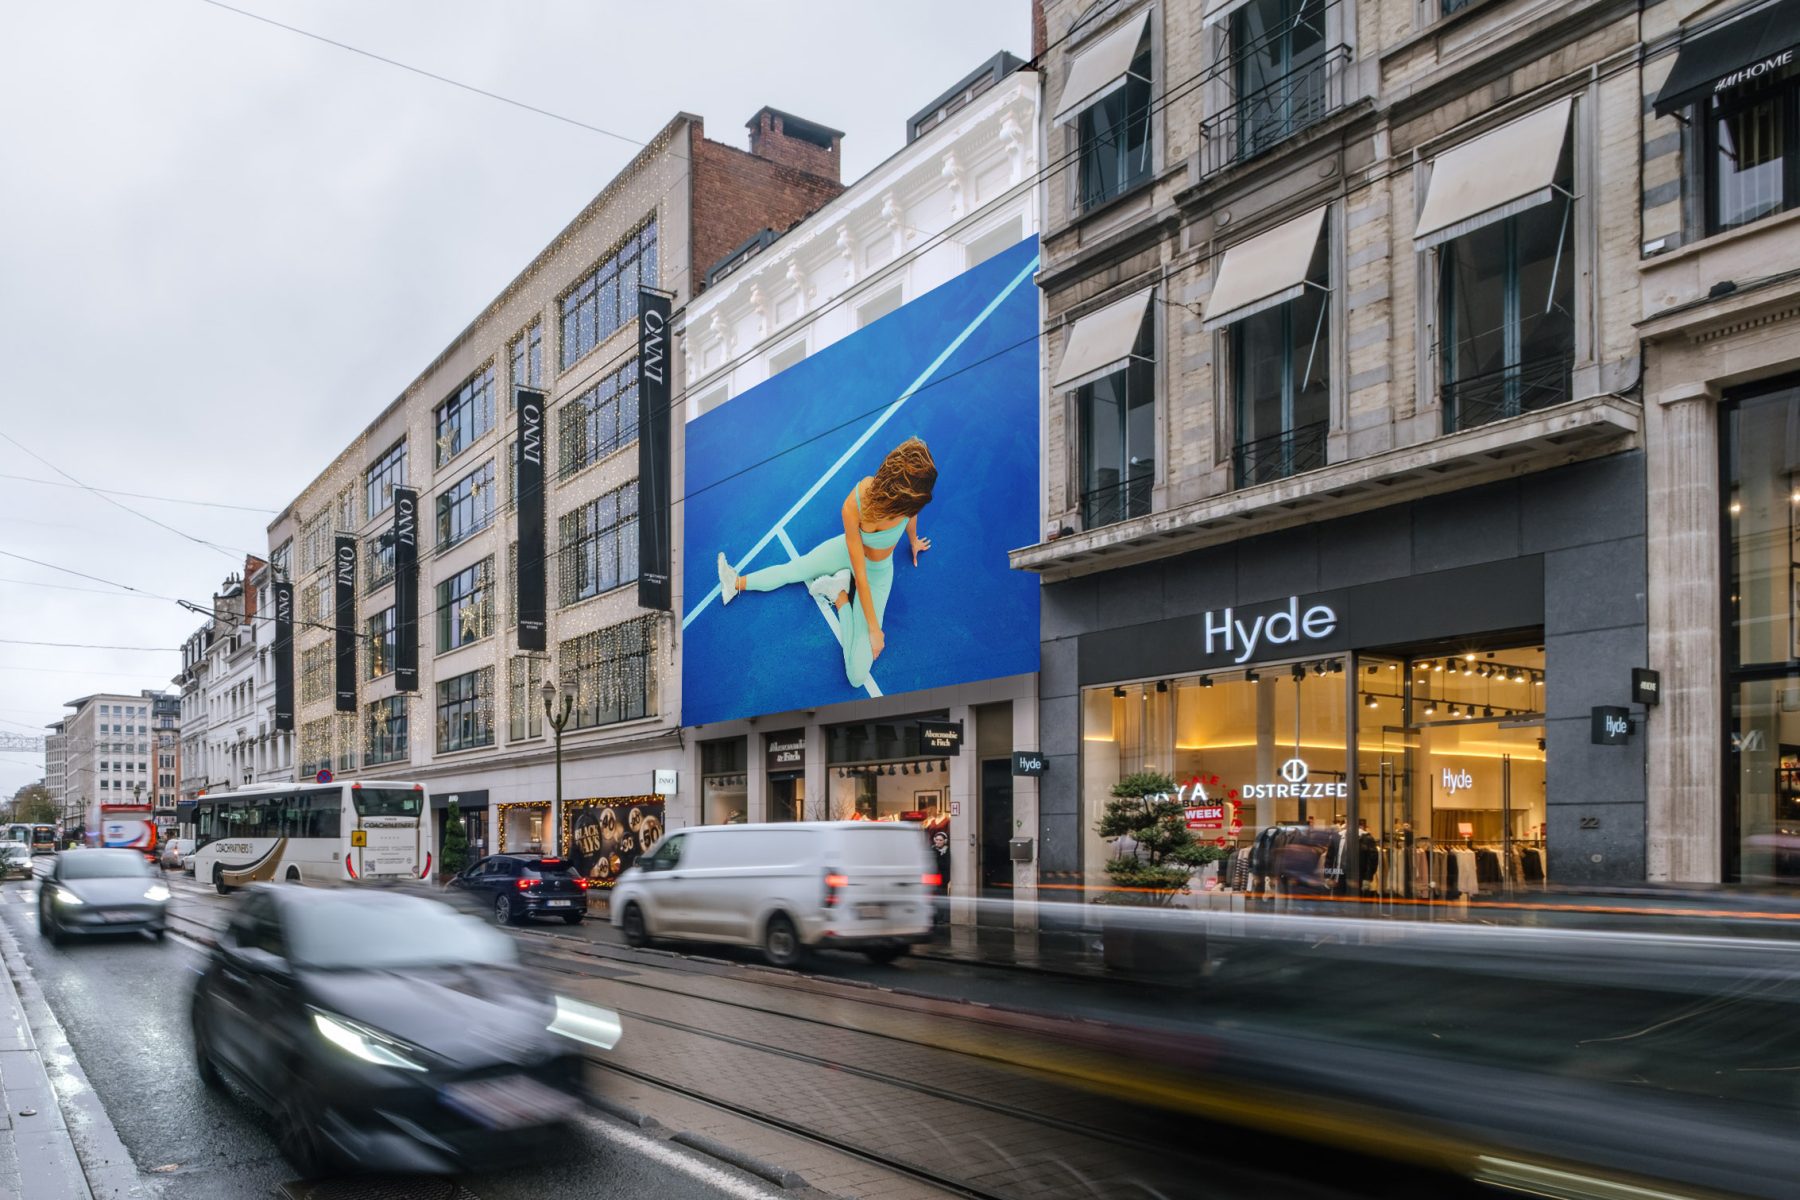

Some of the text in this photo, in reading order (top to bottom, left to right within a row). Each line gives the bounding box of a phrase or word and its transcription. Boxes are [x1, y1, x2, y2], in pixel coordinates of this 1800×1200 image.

[1738, 50, 1793, 83] HOME
[645, 310, 663, 385] INNO
[524, 404, 540, 466] INNO
[399, 498, 415, 546] INNO
[339, 546, 354, 587] INNO
[1205, 596, 1337, 663] Hyde
[1606, 715, 1627, 737] Hyde
[925, 730, 958, 740] Abercrombie
[936, 738, 951, 747] Fitch
[769, 739, 805, 752] Abercrombi
[1019, 757, 1041, 771] Hyde
[658, 777, 674, 785] INNO
[1443, 767, 1472, 794] Hyde
[1243, 783, 1348, 798] DSTREZZED
[1183, 798, 1224, 808] BLACK
[1184, 808, 1222, 820] WEEK
[1580, 817, 1599, 829] 22
[575, 825, 599, 841] BLACK
